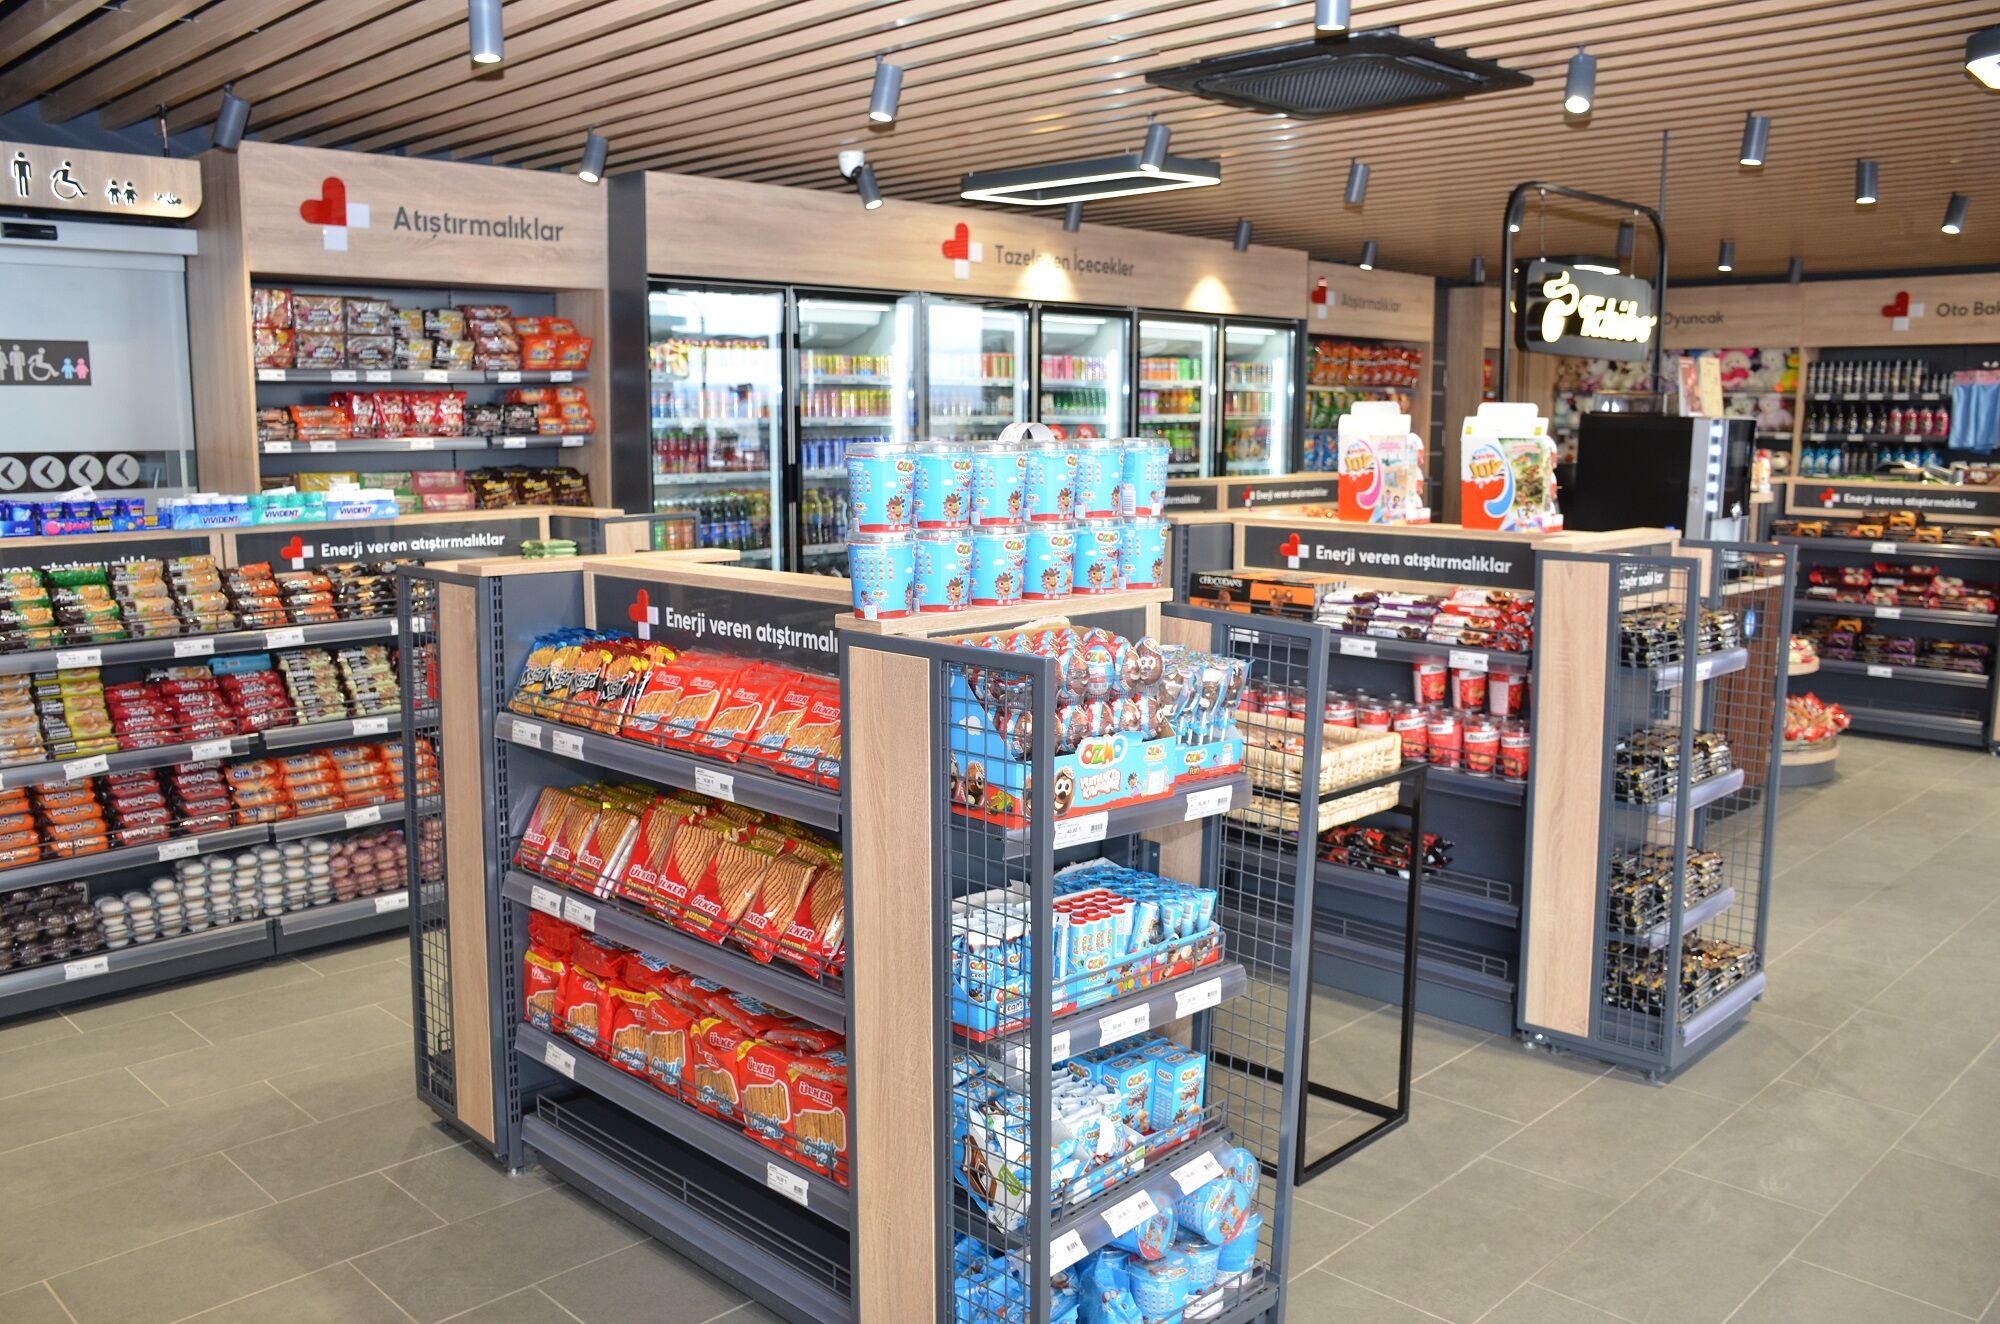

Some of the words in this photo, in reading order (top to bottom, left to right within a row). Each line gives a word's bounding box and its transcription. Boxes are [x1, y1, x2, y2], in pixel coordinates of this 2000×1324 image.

[393, 206, 564, 242] Atıştırmalıklar
[1074, 248, 1134, 277] İçecekler
[1936, 303, 1968, 317] Oto
[1843, 493, 1873, 506] Enerji
[1873, 496, 1903, 505] veren
[321, 541, 362, 558] Enerji
[367, 540, 407, 554] veren
[411, 533, 505, 552] atıştırmalıklar
[1316, 544, 1356, 565] Enerji
[1359, 551, 1400, 566] veren
[1403, 553, 1512, 574] atıştırmalıklar
[666, 606, 705, 638] Enerji
[709, 619, 752, 640] veren
[1087, 650, 1110, 663] OZMO
[655, 671, 681, 686] ÜLKER
[690, 677, 716, 688] ÜLKER
[734, 688, 758, 702] ÜLKER
[784, 691, 811, 705] ÜLKER
[812, 702, 840, 717] ÜLKER
[1080, 737, 1126, 766] OZMO
[1184, 749, 1208, 765] OZMO
[629, 864, 657, 884] ÜLKER
[691, 894, 721, 917] ÜLKER
[1087, 955, 1109, 970] OZMO
[747, 1057, 775, 1078] ÜLKER
[799, 1081, 833, 1105] ÜLKER
